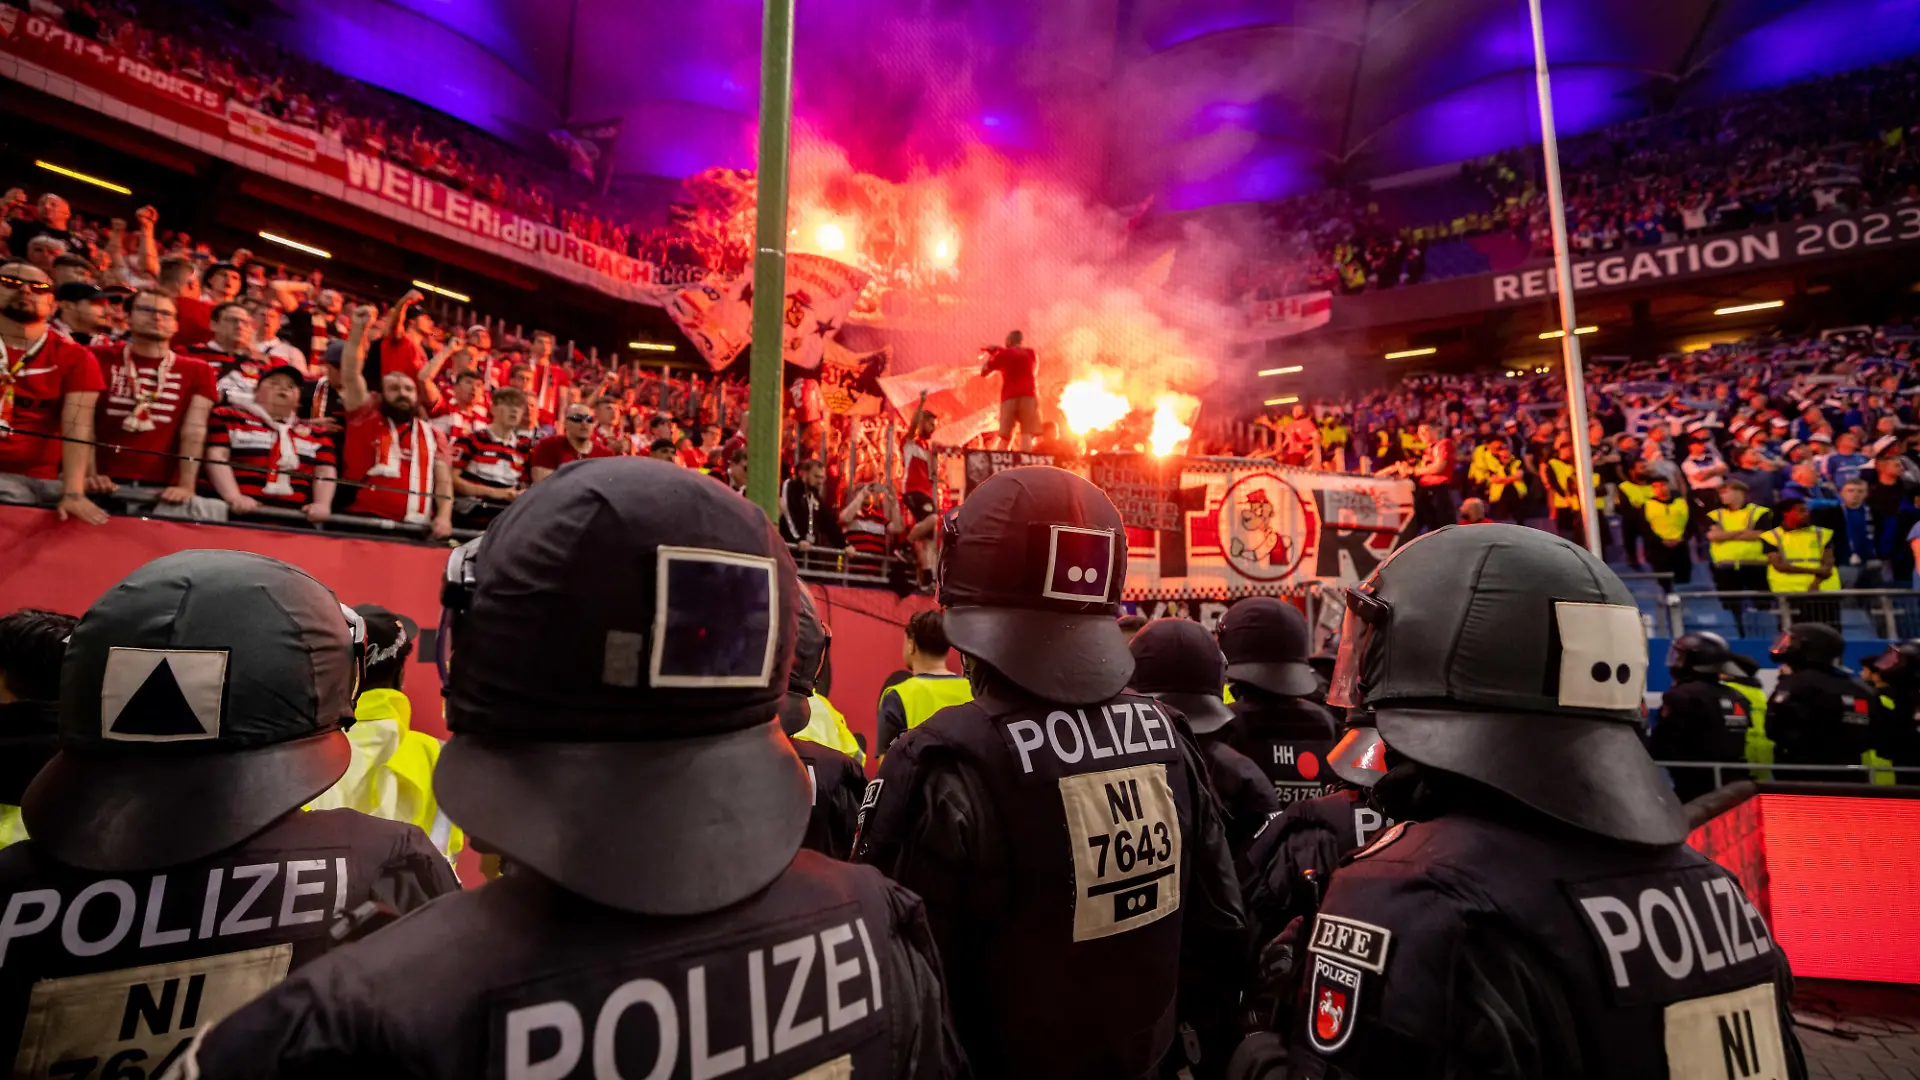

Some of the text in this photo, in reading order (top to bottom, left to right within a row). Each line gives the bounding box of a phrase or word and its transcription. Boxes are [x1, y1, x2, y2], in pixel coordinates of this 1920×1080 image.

[543, 227, 651, 284] URBACH
[1795, 208, 1920, 256] 2023
[1007, 703, 1176, 774] POLIZEI
[1273, 745, 1295, 765] HH
[1105, 779, 1144, 825] NI
[1088, 821, 1172, 879] 7643
[0, 857, 348, 968] POLIZEI
[1318, 922, 1372, 959] BFE
[505, 918, 883, 1080] POLIZEI
[1316, 961, 1358, 988] POLIZEI
[118, 973, 206, 1041] NI
[1717, 1009, 1760, 1080] NI
